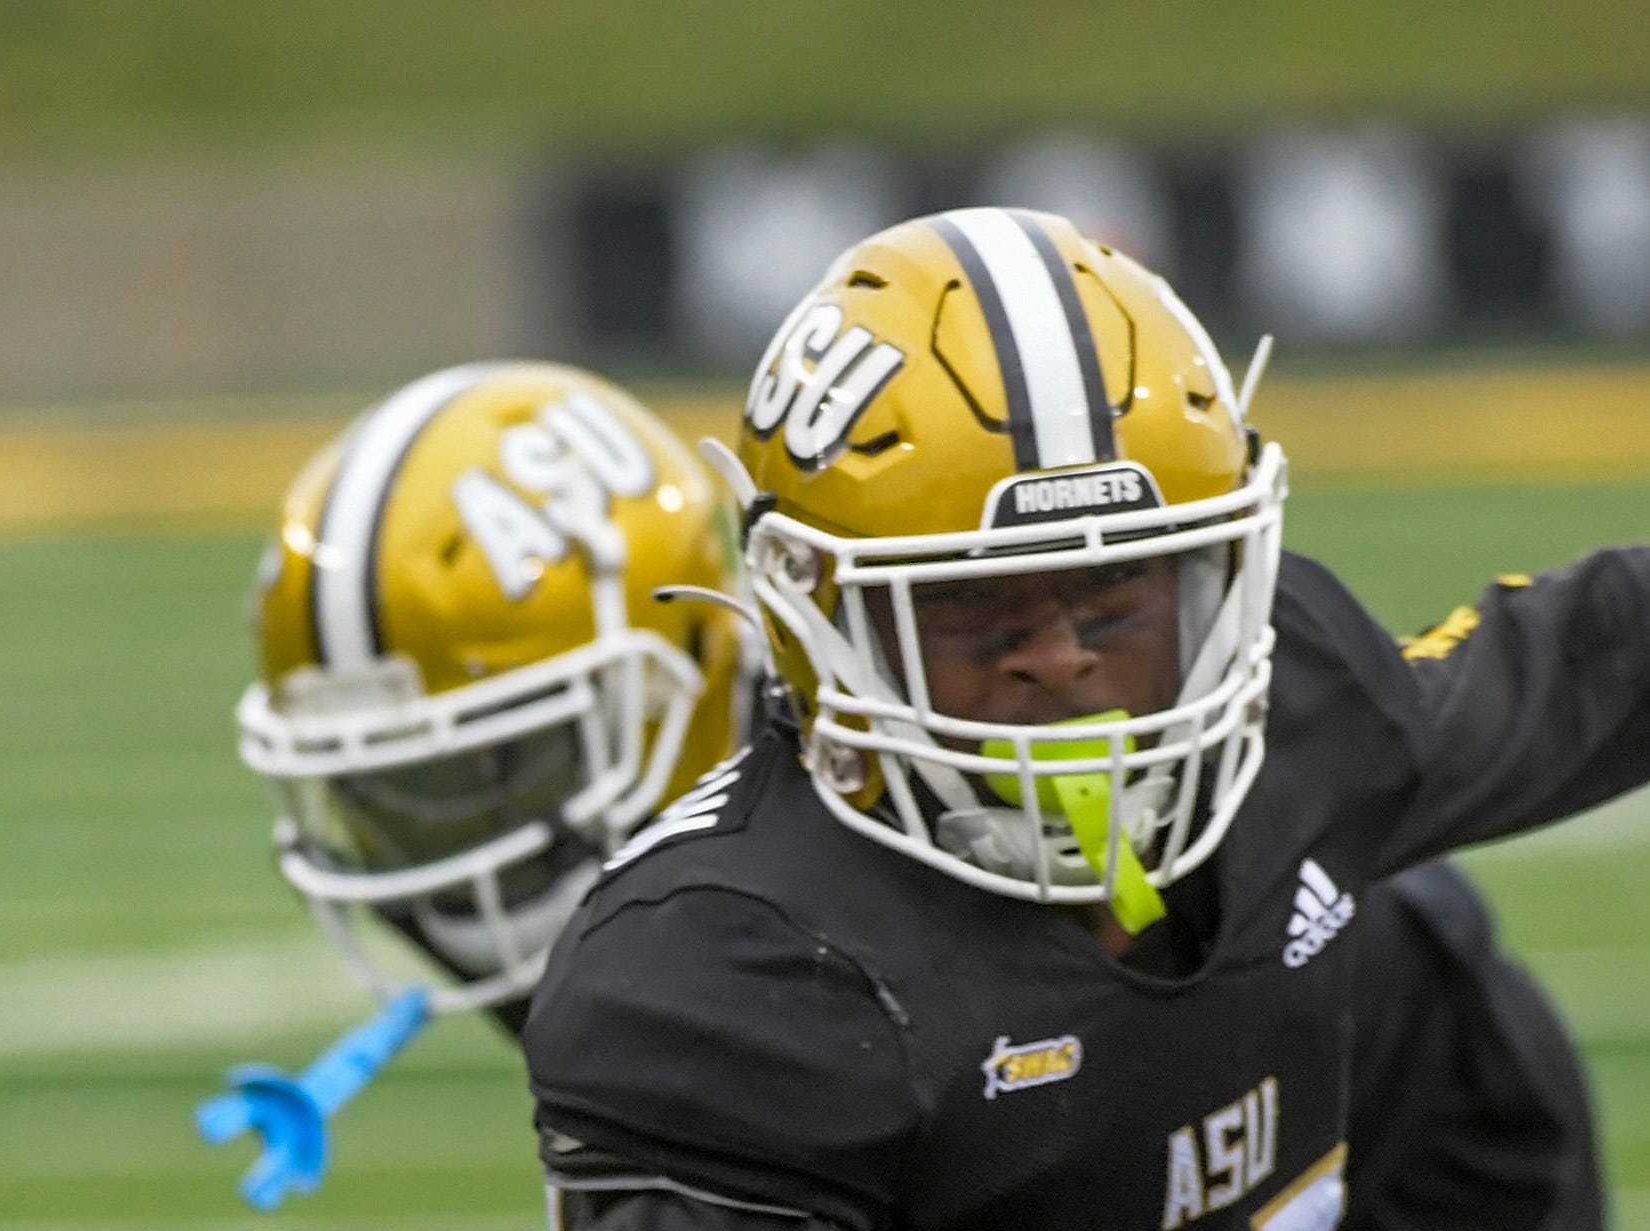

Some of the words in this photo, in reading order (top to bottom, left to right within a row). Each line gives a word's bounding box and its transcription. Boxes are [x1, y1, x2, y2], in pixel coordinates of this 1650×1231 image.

[451, 391, 656, 602] ASU
[1014, 470, 1143, 515] HORNETS
[1160, 1074, 1279, 1231] ASU
